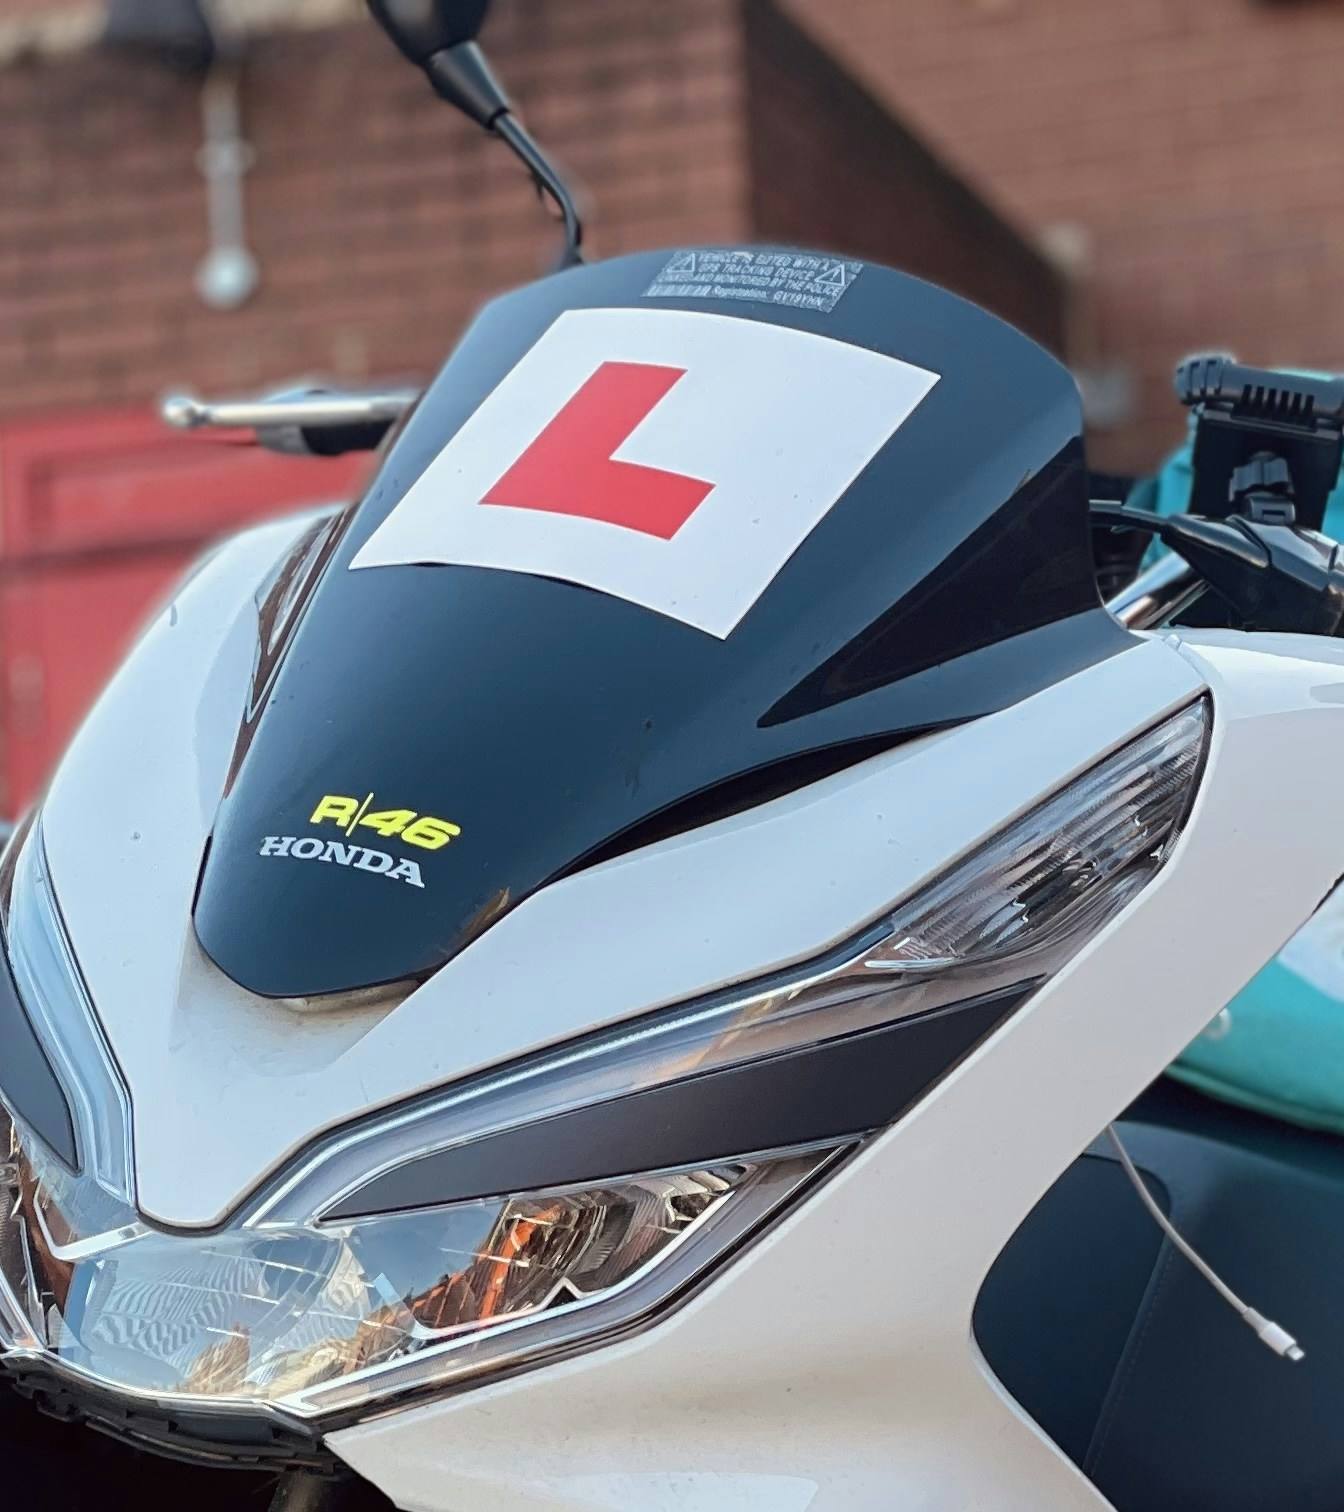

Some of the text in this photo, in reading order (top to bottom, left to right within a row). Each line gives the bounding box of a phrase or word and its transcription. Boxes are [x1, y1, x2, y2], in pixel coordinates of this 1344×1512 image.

[722, 263, 774, 276] TRACKING
[775, 267, 815, 281] DEVICE
[785, 279, 806, 291] THE
[478, 361, 716, 541] L
[259, 836, 425, 888] HONDA
